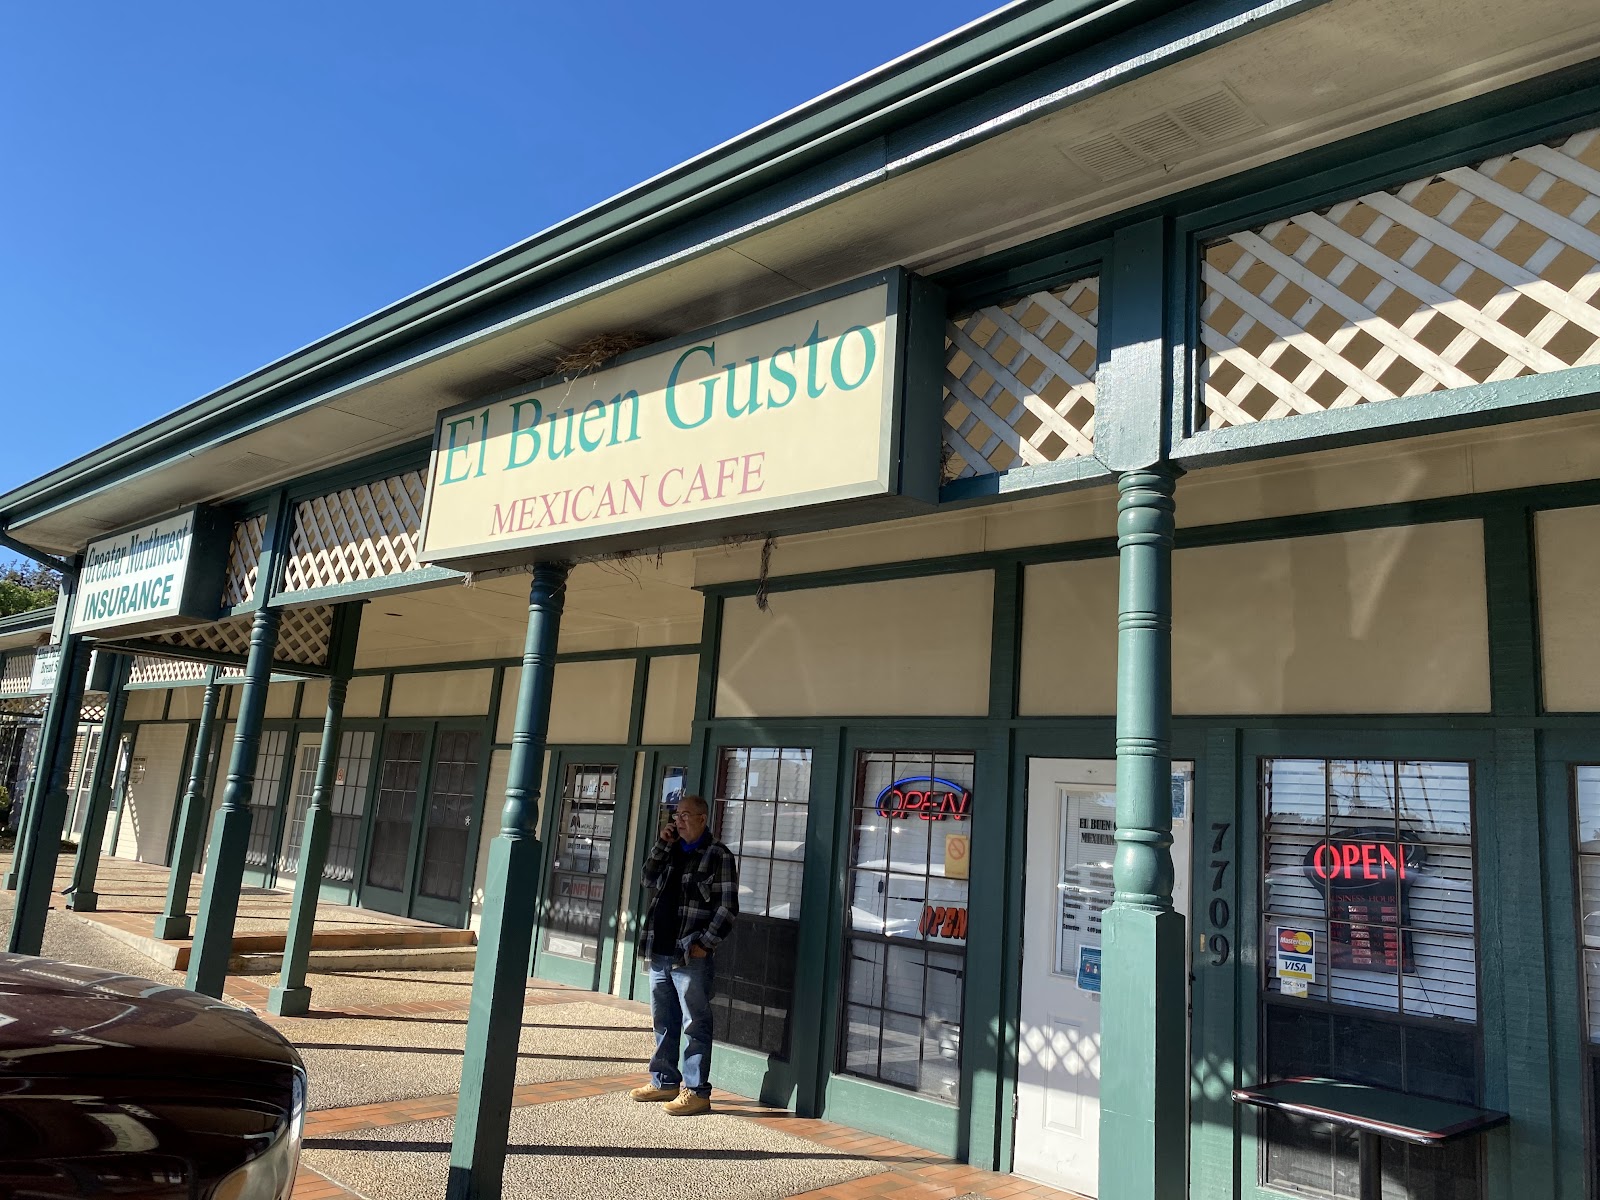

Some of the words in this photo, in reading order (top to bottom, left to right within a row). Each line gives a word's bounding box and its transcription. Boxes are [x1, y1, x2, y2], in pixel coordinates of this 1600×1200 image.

[439, 408, 491, 486] El
[502, 387, 642, 471] Buen
[665, 319, 877, 430] Gusto
[488, 474, 648, 537] MEXICAN
[657, 452, 766, 508] CAFE
[86, 543, 127, 584] Greater
[126, 520, 189, 574] Northwest
[82, 574, 175, 621] INSURANCE
[577, 785, 604, 793] TRAVELES
[880, 789, 969, 821] OPEN
[1079, 818, 1088, 829] EL
[1090, 818, 1111, 831] BUEN
[1081, 832, 1117, 846] MEXICAN
[1313, 843, 1406, 879] OPEN
[1208, 822, 1231, 967] 7709
[1329, 894, 1366, 902] USINESS
[1368, 895, 1399, 903] HOUR
[918, 905, 968, 940] OPEN
[1279, 936, 1311, 947] MasterCard
[1284, 961, 1307, 973] VISA
[1282, 980, 1306, 989] DISCOVER
